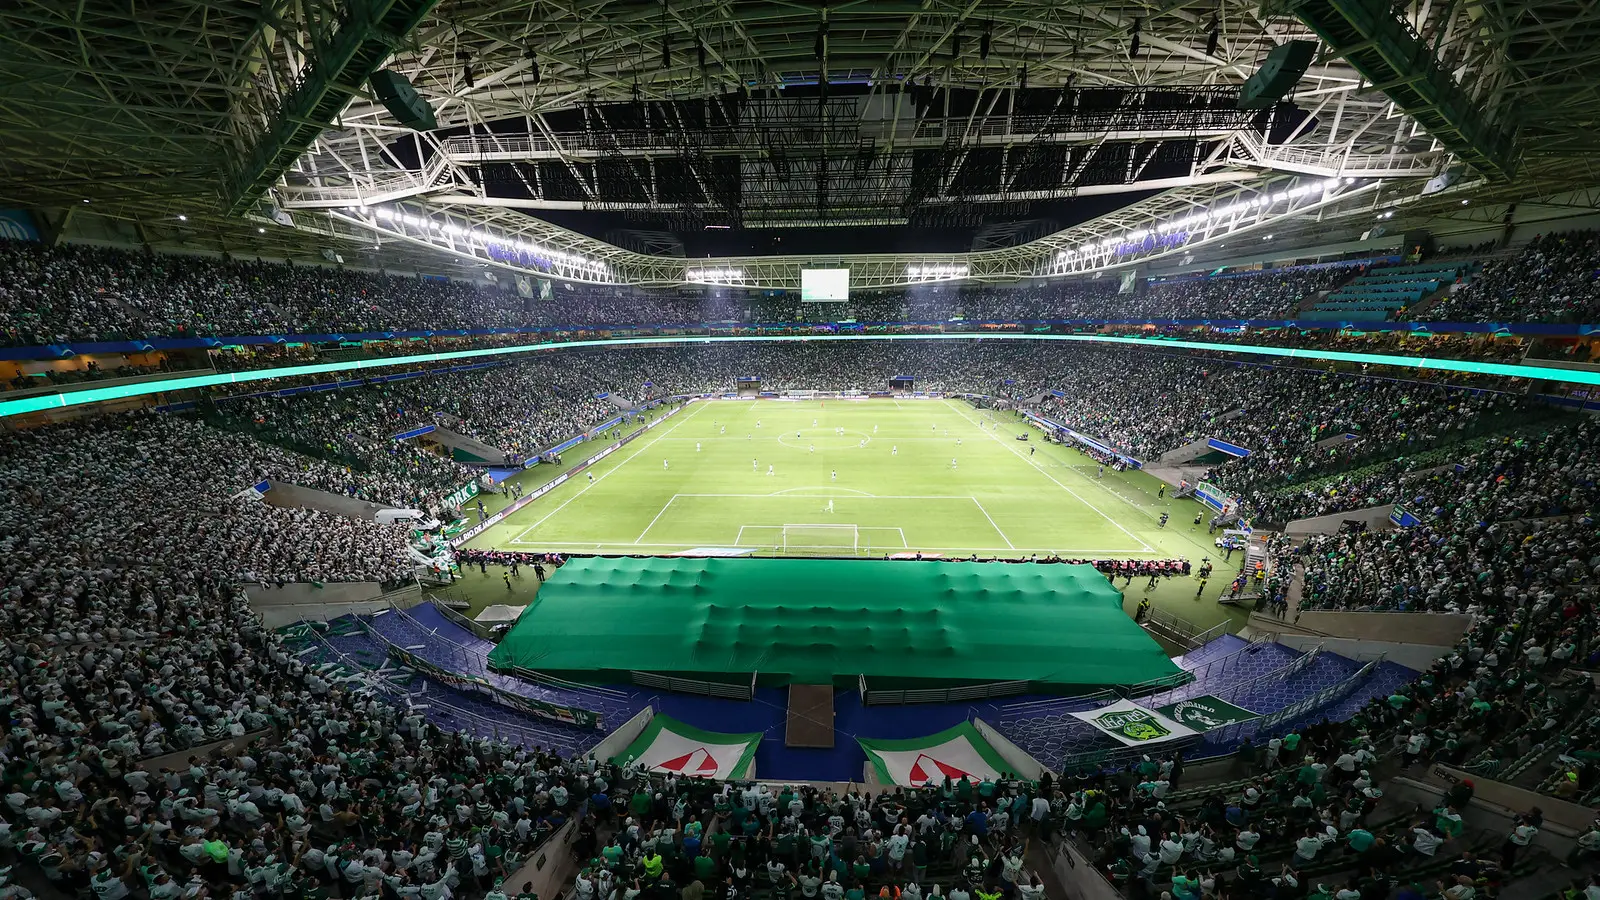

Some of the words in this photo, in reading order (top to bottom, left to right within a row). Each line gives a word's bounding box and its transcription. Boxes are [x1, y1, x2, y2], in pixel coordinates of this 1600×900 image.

[463, 529, 474, 541] RIO
[473, 524, 483, 535] DE
[482, 512, 503, 530] JANEIRO
